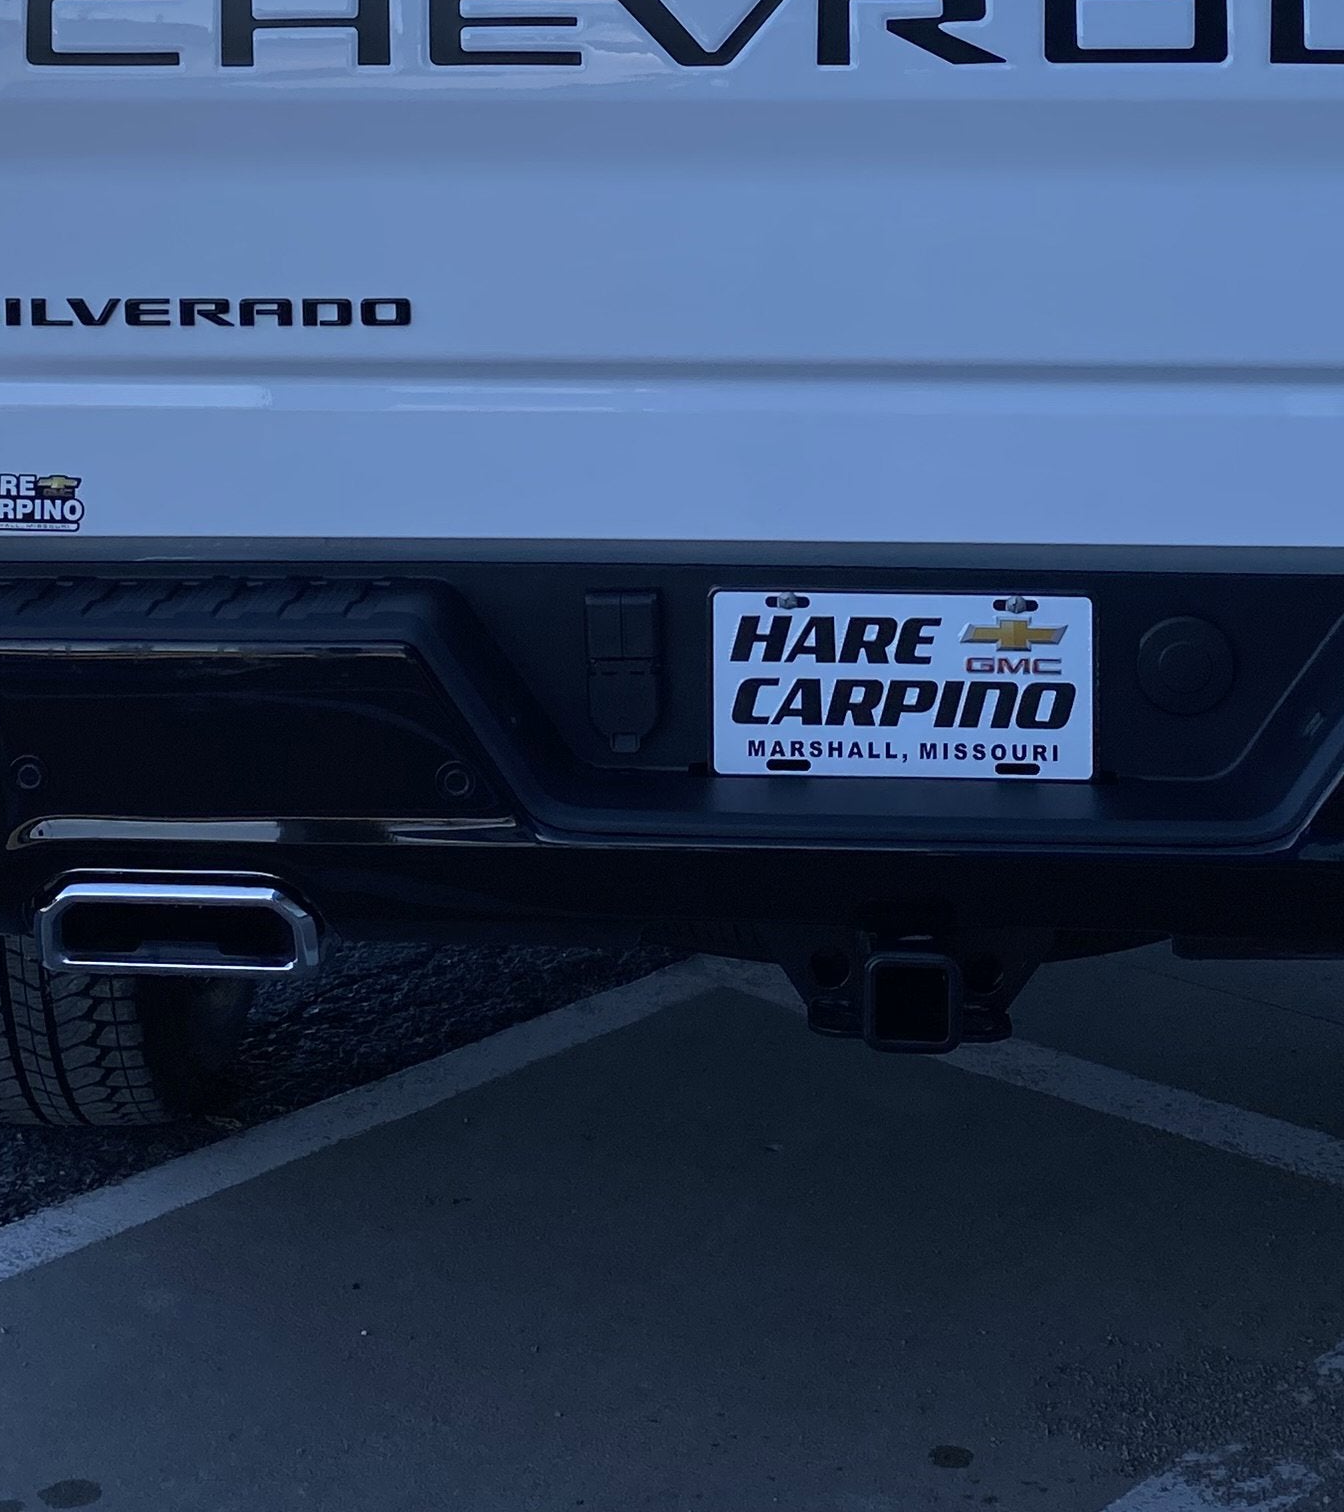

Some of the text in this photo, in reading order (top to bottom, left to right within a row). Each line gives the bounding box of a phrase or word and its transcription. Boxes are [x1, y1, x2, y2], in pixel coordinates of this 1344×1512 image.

[729, 614, 942, 665] HARE
[964, 656, 1063, 676] GMC
[731, 677, 1077, 730] CARPINO
[747, 739, 1060, 764] MARSHALL, MISSOURI
